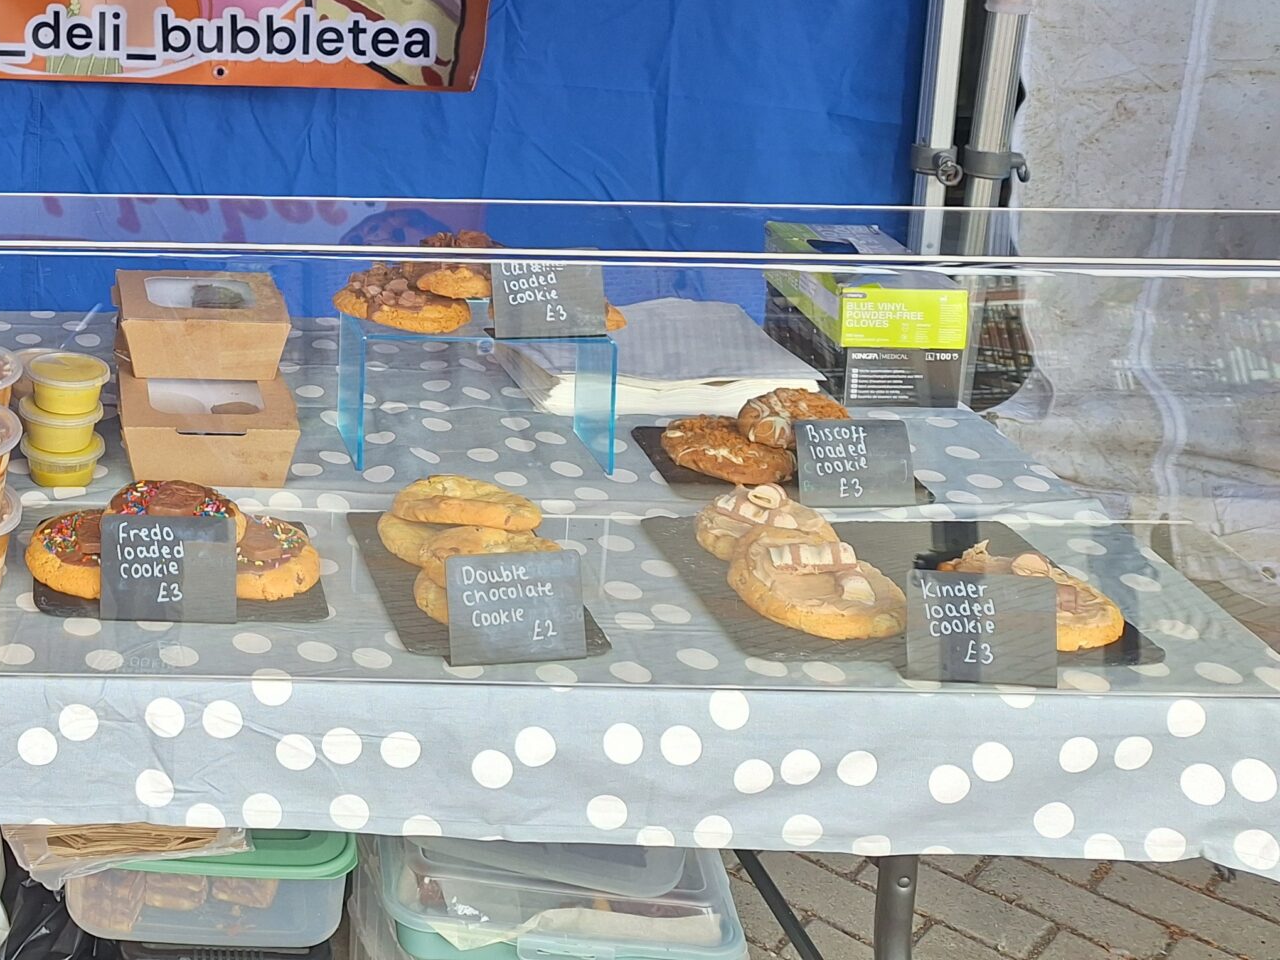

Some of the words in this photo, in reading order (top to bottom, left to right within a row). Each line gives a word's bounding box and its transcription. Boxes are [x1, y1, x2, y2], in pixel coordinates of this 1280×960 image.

[503, 271, 557, 293] loaded
[508, 287, 559, 305] cookie
[546, 303, 568, 322] £3
[846, 301, 875, 311] BLUE
[877, 302, 909, 312] VINYL
[846, 310, 925, 321] POWDER-FREE
[845, 319, 890, 329] GLOVES
[935, 352, 952, 361] 100
[805, 424, 868, 443] Biscoff
[810, 442, 867, 459] loaded
[816, 456, 869, 476] cookie
[839, 477, 864, 498] £3
[119, 522, 175, 544] Fredo
[117, 540, 185, 560] loaded
[120, 559, 180, 579] cookie
[461, 565, 529, 585] Double
[157, 582, 183, 602] £3
[920, 579, 989, 600] Kinder
[924, 599, 996, 620] loaded
[532, 620, 558, 641] £2
[929, 617, 995, 637] cookie
[964, 640, 994, 665] £3
